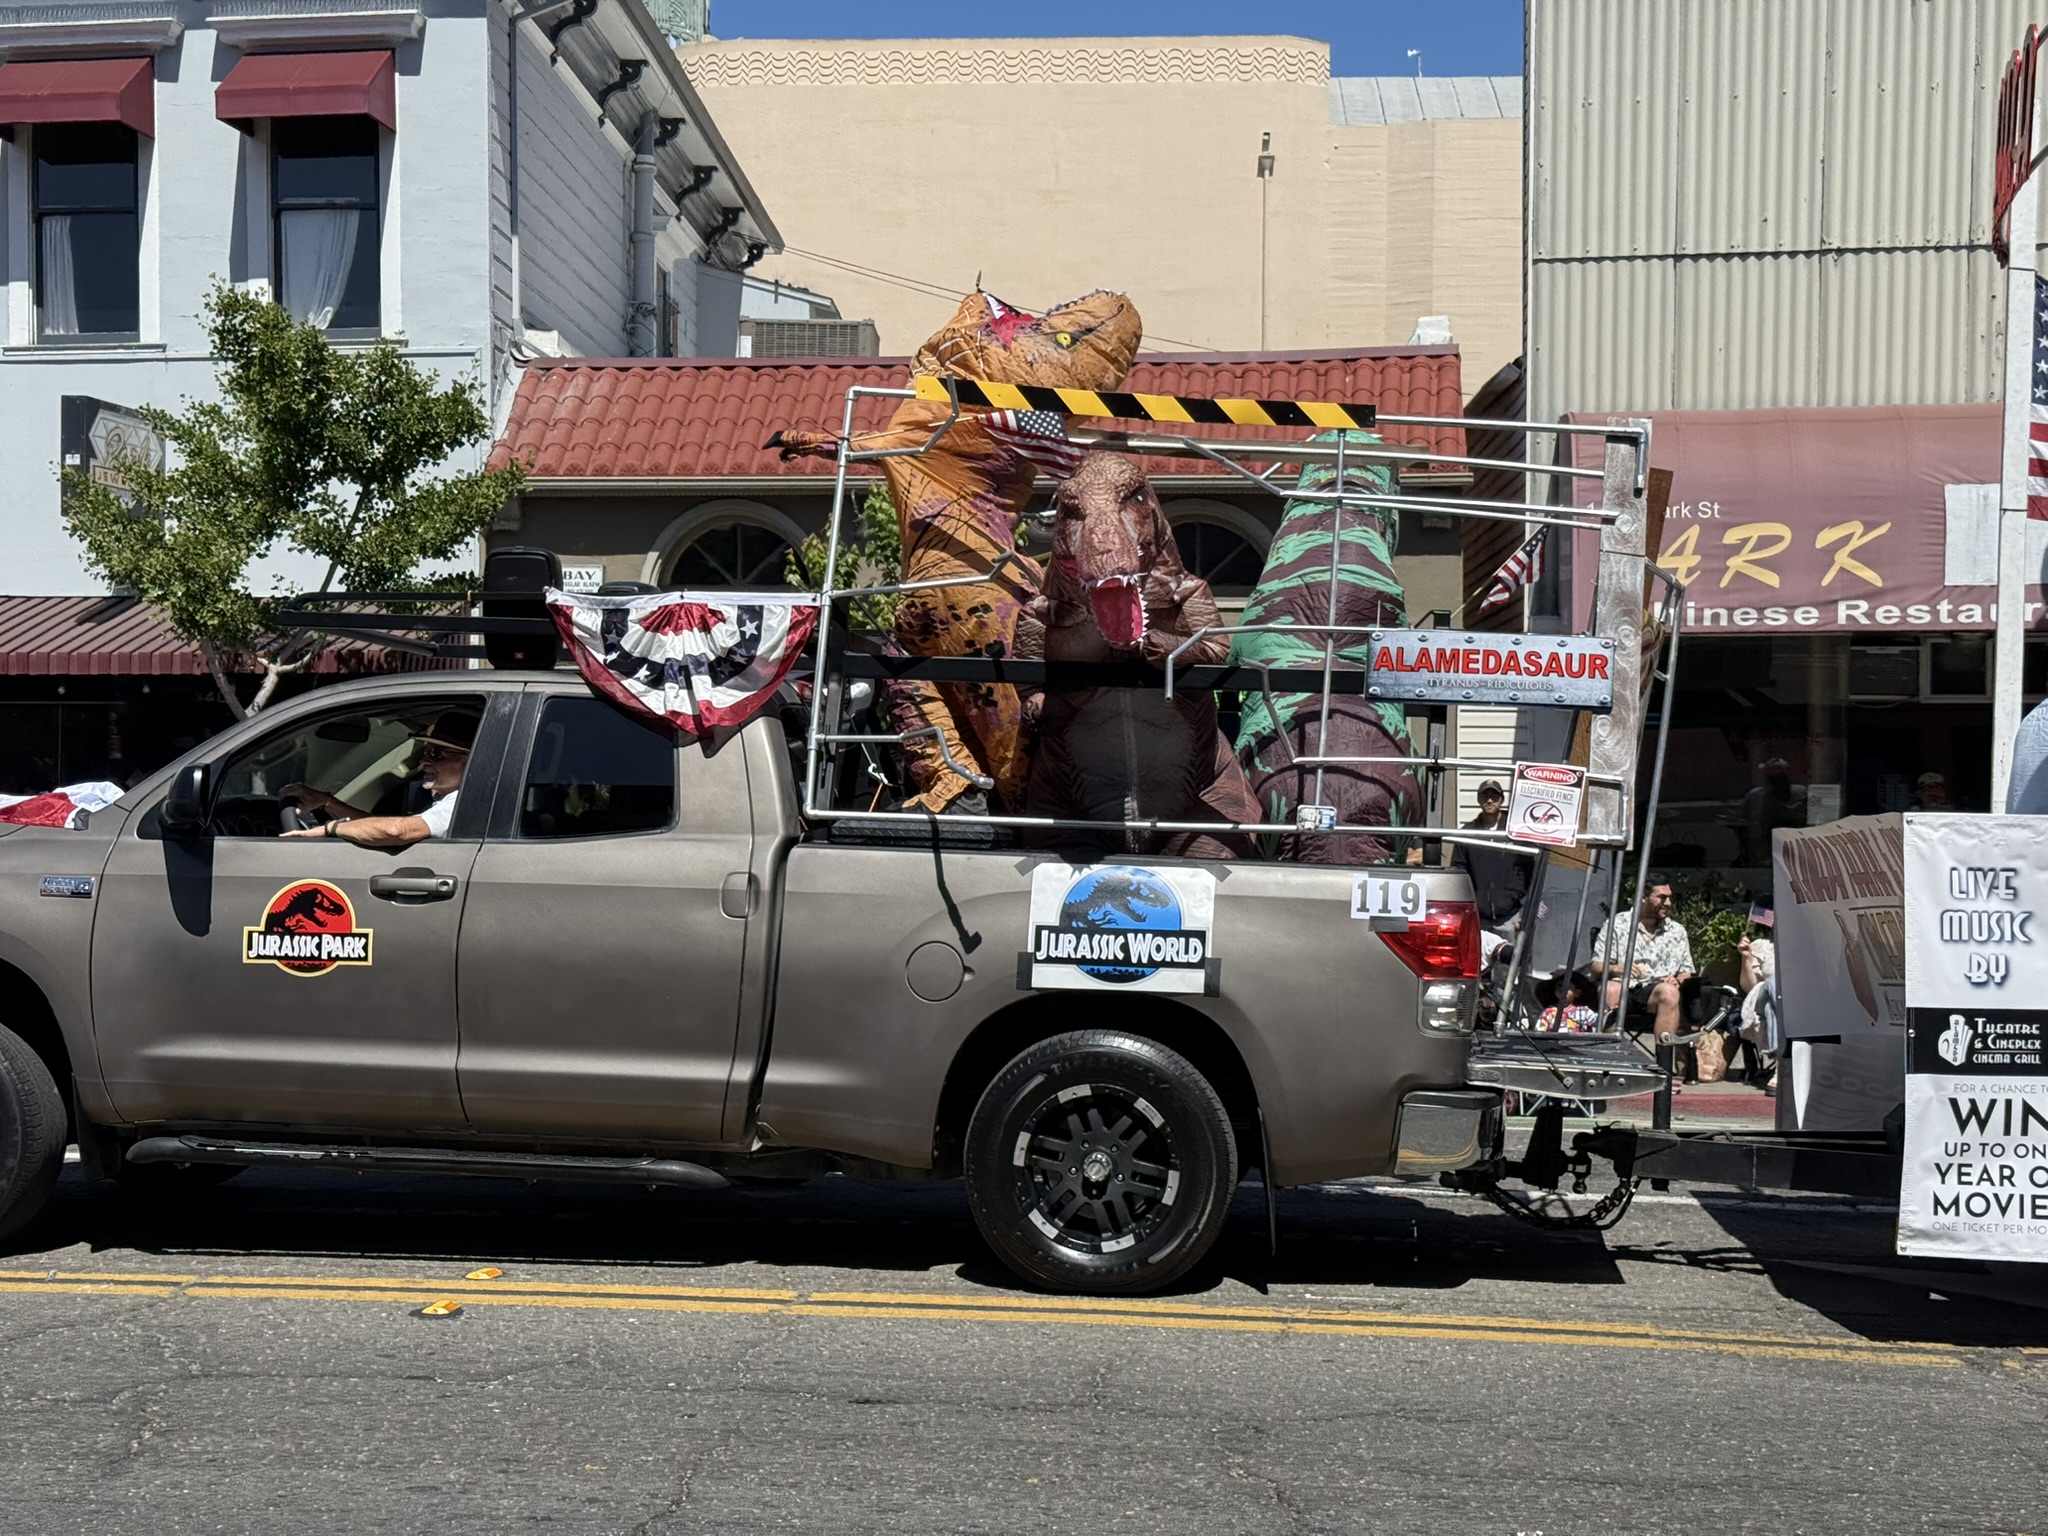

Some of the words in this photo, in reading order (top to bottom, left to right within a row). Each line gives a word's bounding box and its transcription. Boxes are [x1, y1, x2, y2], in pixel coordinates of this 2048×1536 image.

[1664, 501, 1692, 519] ark
[1697, 501, 1720, 519] St
[1656, 522, 1891, 588] ARK
[564, 571, 596, 580] BAY
[1653, 601, 1820, 627] hinese
[1837, 599, 2048, 625] Restar
[1373, 646, 1610, 680] ALAMEDASAUR
[1527, 769, 1574, 782] WARNING
[1520, 785, 1555, 798] ELECTRIFIED
[1556, 790, 1574, 802] FENCE
[1950, 867, 2016, 900] LIVE
[1356, 879, 1420, 915] 119
[1941, 909, 2032, 942] MUSIC
[248, 932, 320, 958] JURASSIC
[321, 933, 367, 960] PARK
[1036, 930, 1125, 960] JURASSIC
[1127, 933, 1203, 964] WORLD
[1964, 952, 2008, 985] BY
[1974, 1017, 2041, 1034] THEATRE
[1987, 1033, 2042, 1049] CINEPLEX
[1972, 1053, 2011, 1064] CINEMA
[2014, 1054, 2042, 1064] GRILL
[1953, 1083, 1976, 1093] FOR
[1980, 1084, 1988, 1094] A
[1990, 1084, 2037, 1094] CHANCE
[1947, 1097, 2048, 1137] WIN
[1944, 1142, 1972, 1157] UP
[1979, 1142, 2006, 1158] TO
[1933, 1162, 2017, 1187] YEAR
[1932, 1190, 2048, 1220] MOVIE
[1932, 1221, 1959, 1231] ONE
[1962, 1222, 1999, 1233] TICKET
[2003, 1224, 2024, 1234] PER
